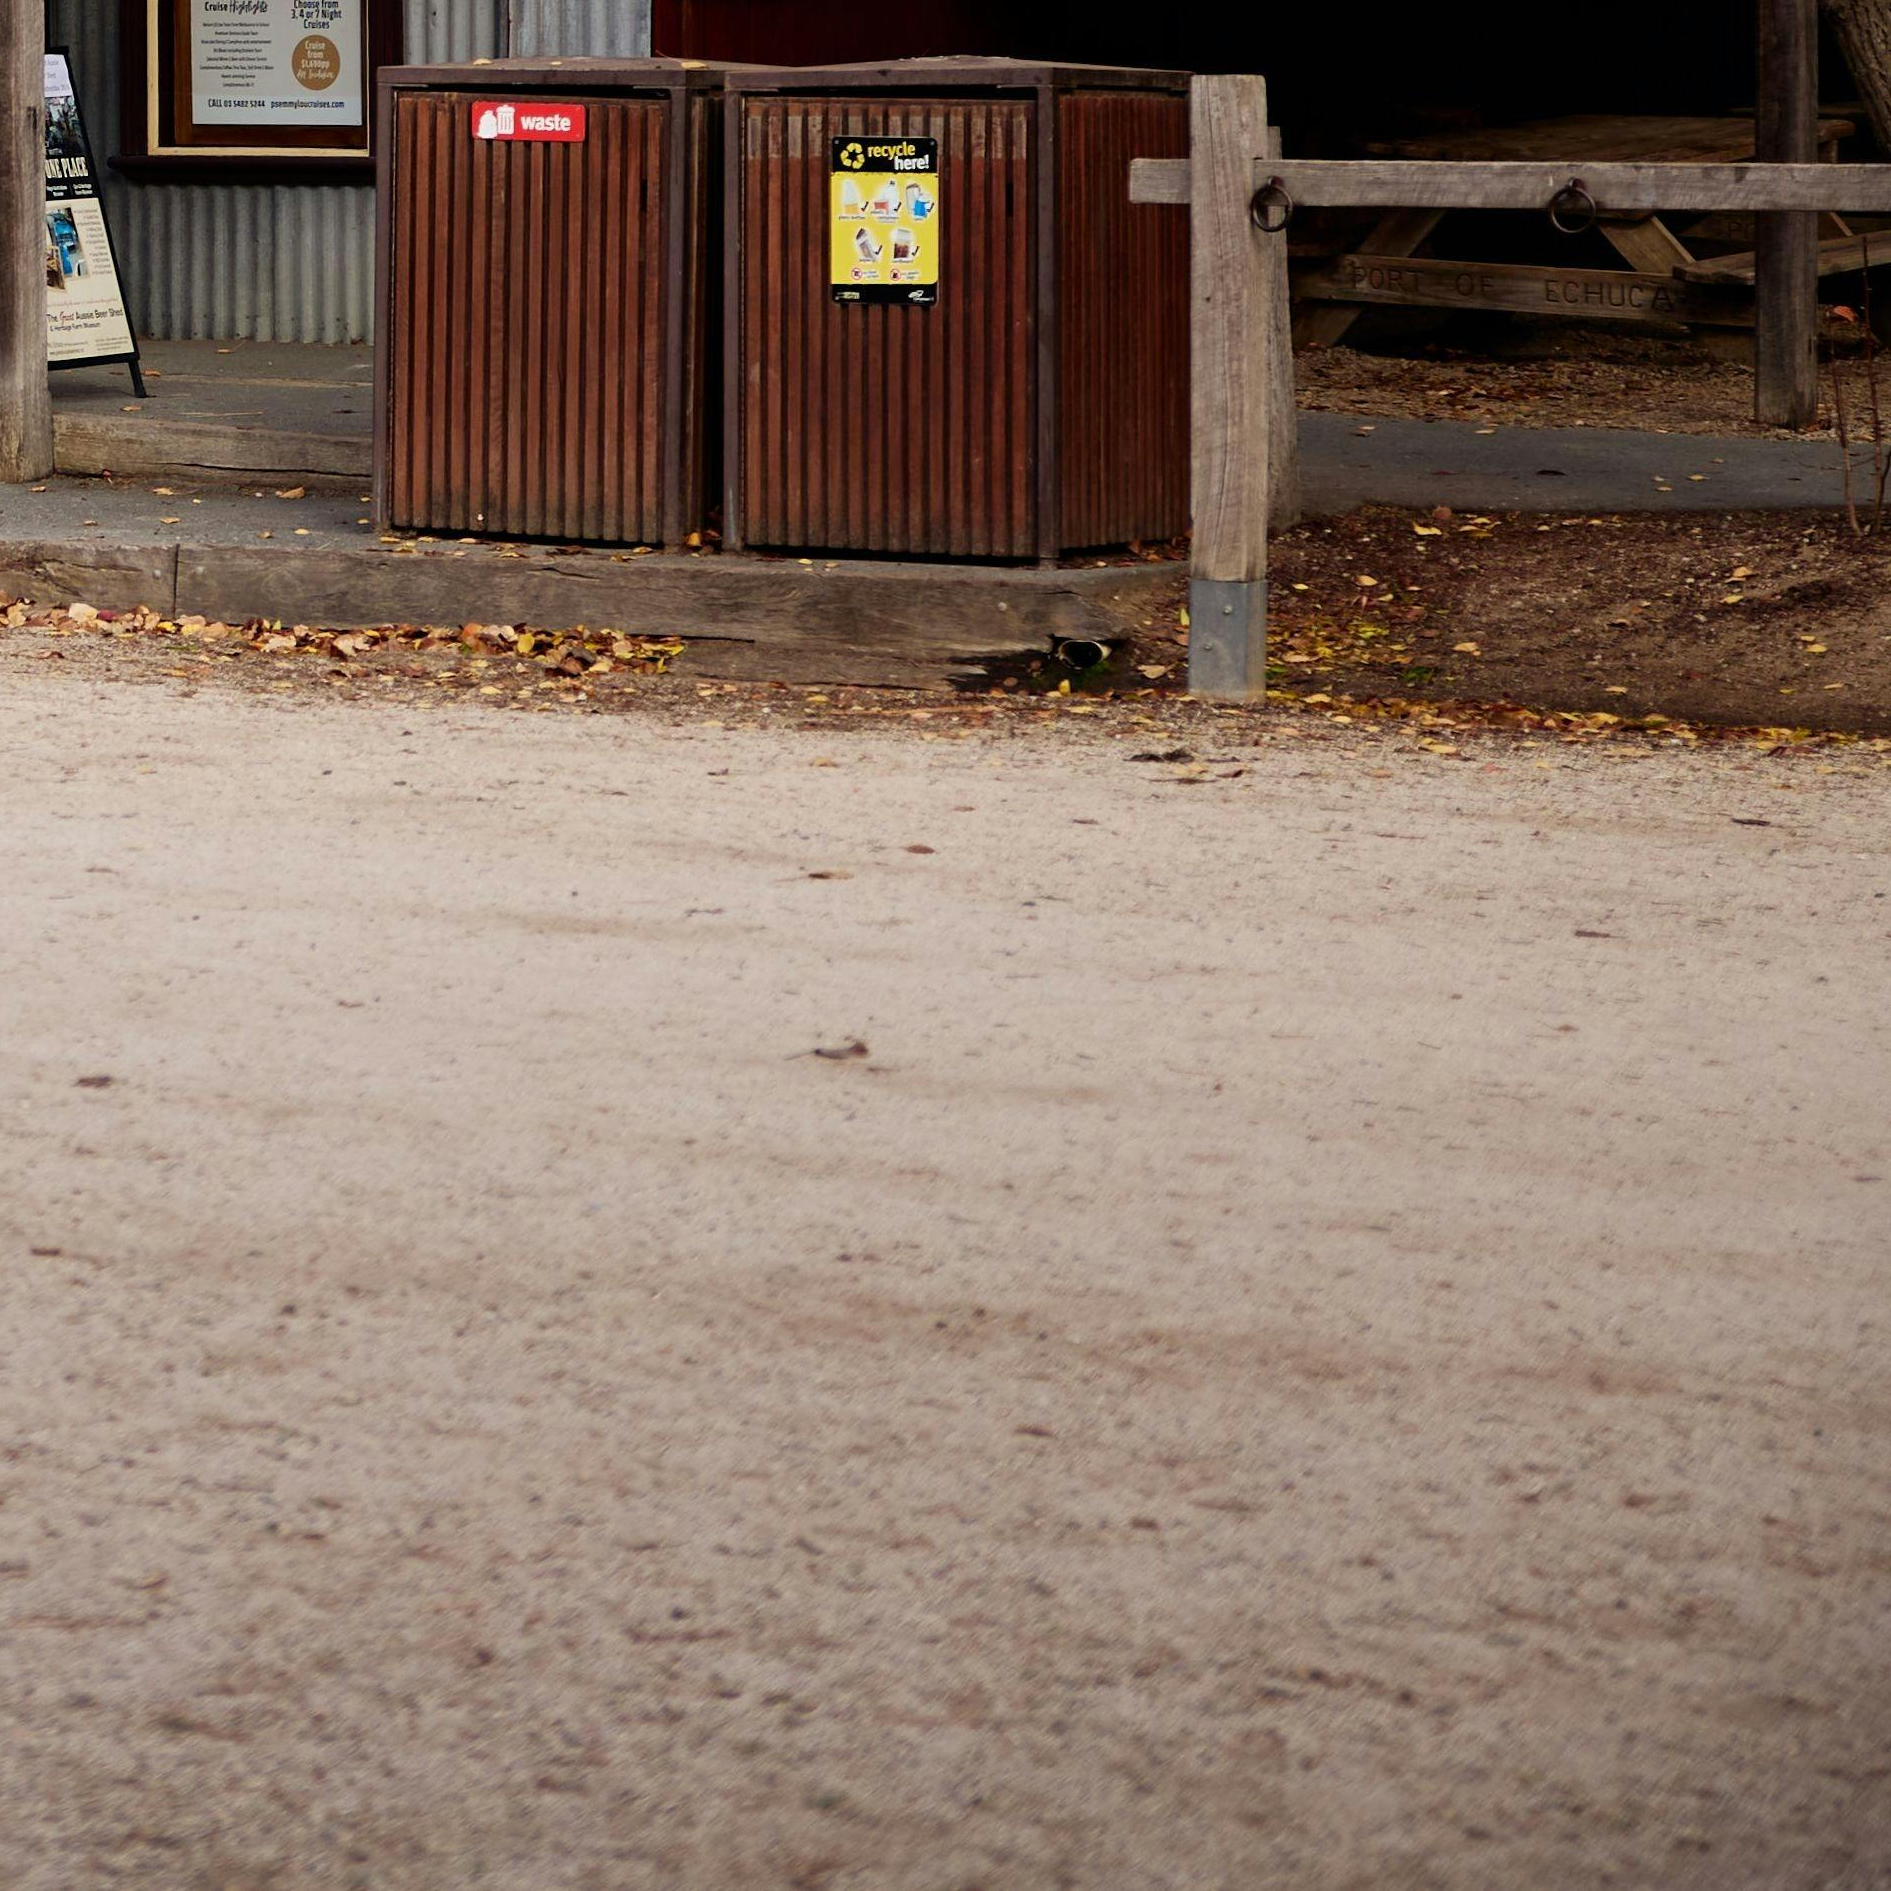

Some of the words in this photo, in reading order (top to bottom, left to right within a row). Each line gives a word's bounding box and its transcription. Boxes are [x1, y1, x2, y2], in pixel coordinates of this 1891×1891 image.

[204, 1, 228, 12] Cruise
[293, 0, 320, 9] Choose
[321, 0, 339, 8] from
[300, 9, 306, 19] 4
[315, 9, 320, 18] 7
[321, 10, 342, 20] Night
[304, 20, 330, 29] Cruises
[305, 40, 326, 50] Cruise
[308, 50, 324, 59] from
[208, 98, 222, 108] CALL
[520, 113, 571, 132] waste
[867, 141, 916, 161] recycle
[61, 156, 89, 178] PLACE
[894, 154, 930, 170] here!
[1353, 266, 1421, 293] PORT
[1455, 273, 1493, 297] OF
[1545, 279, 1671, 310] ECHUCA
